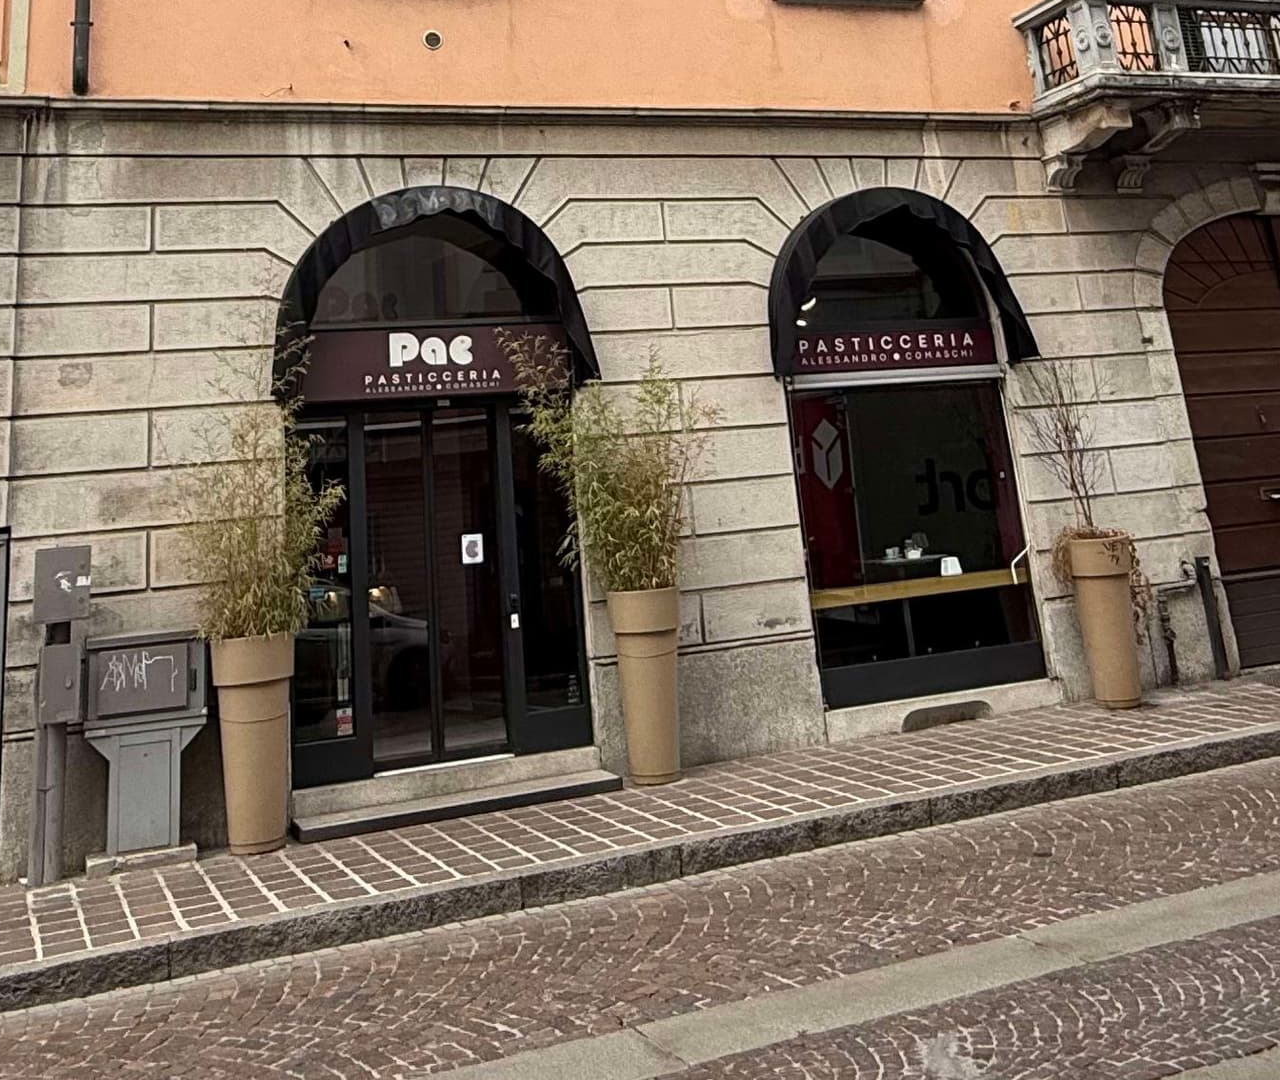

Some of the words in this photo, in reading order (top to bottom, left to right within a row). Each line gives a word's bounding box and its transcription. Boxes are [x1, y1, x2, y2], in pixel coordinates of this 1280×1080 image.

[799, 332, 974, 354] PASTICCERIA
[801, 353, 887, 366] ALESSANDRO
[905, 348, 974, 360] COMASCHI
[364, 369, 501, 386] PASTICCERIA
